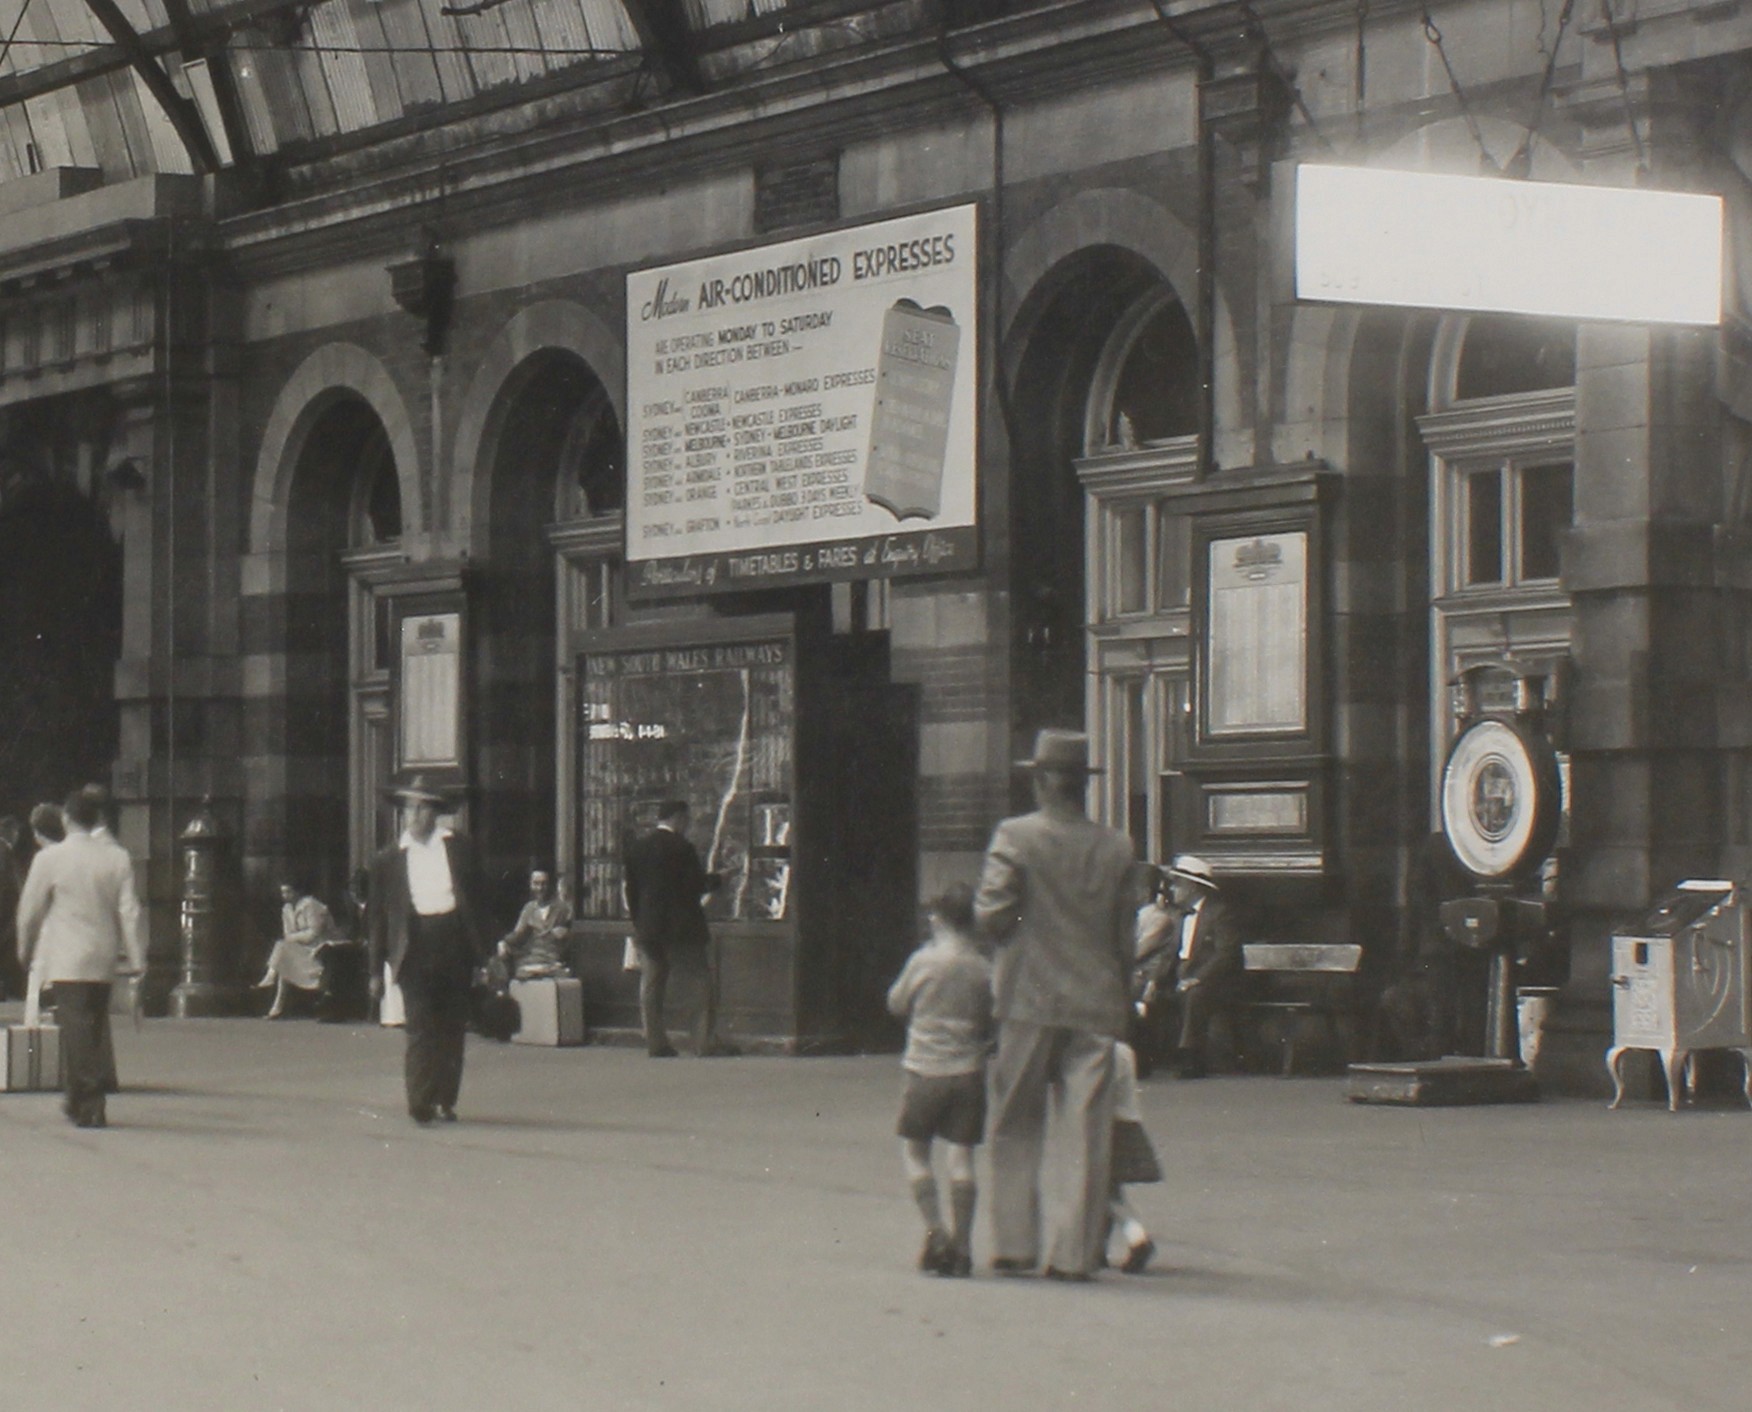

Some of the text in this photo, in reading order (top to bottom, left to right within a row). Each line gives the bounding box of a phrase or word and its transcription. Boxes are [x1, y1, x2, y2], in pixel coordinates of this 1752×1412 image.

[641, 234, 955, 321] Modern AIR-CONDITIONED EXPRESSES
[656, 311, 834, 354] ARE OPERATING MONDAY TO SATURDAY
[655, 360, 664, 375] IN
[666, 356, 691, 374] EACH
[694, 348, 743, 370] DIRECTION
[747, 340, 790, 361] BETWEEN
[643, 400, 673, 417] SYDNEY
[824, 369, 874, 390] EXPRESSES
[686, 385, 728, 404] CANBERRA
[643, 426, 672, 442] SYDNEY
[733, 411, 773, 429] NEWCASTLE
[779, 404, 821, 422] EXPRESSES
[643, 441, 672, 458] SYDNEY
[685, 434, 725, 452] MELBOURNE
[820, 415, 857, 433] DAYLIGHT
[778, 437, 822, 456] EXPRESSES
[734, 479, 769, 495] CENTRAL
[802, 469, 847, 487] EXPRESSES
[813, 501, 862, 519] EXPRESSES
[729, 552, 799, 578] TIMETABLES
[804, 554, 814, 571] &
[818, 547, 857, 569] FARES
[665, 649, 709, 670] WALES
